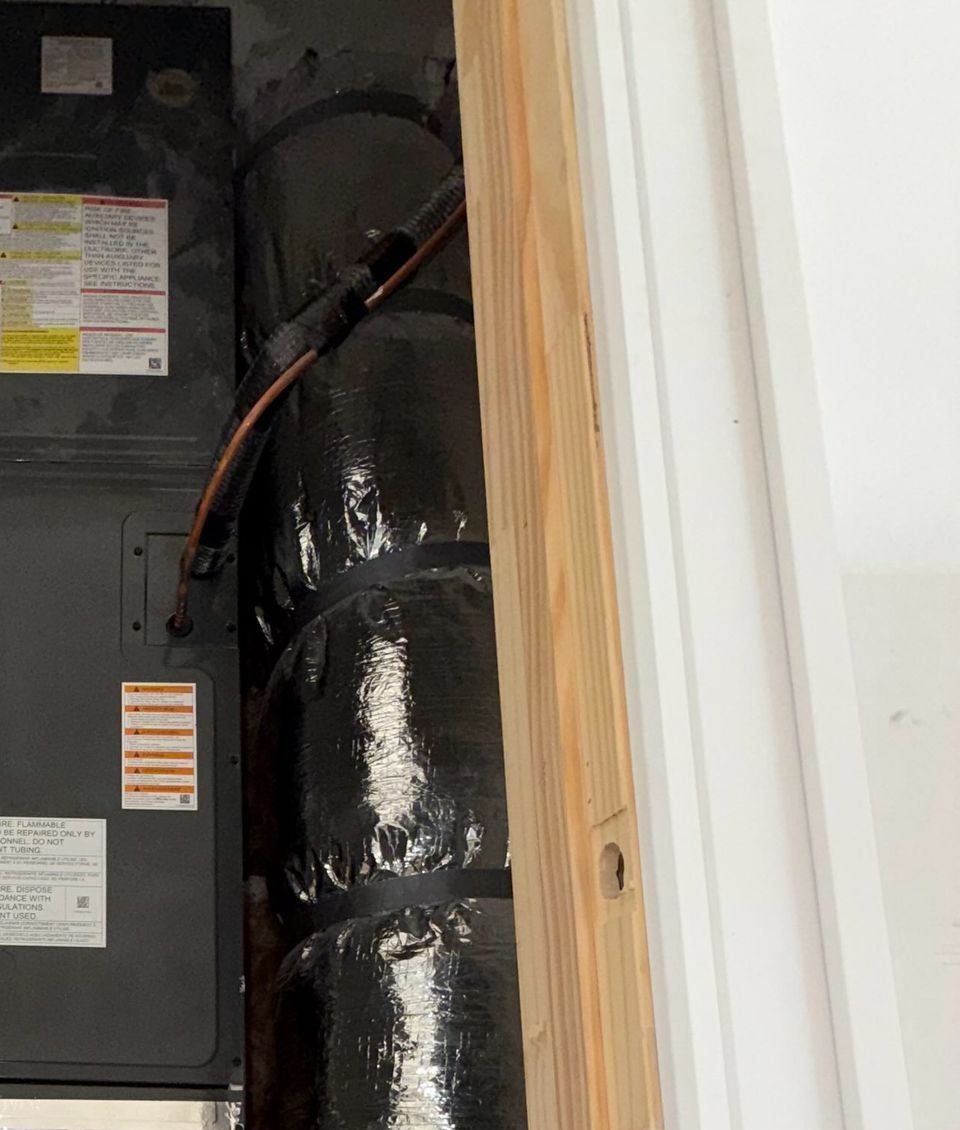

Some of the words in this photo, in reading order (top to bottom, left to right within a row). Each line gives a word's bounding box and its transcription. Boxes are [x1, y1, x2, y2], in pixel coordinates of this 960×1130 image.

[17, 821, 66, 829] FLAMMABLE
[3, 829, 15, 837] BE
[16, 829, 59, 838] REPAIRED
[60, 830, 82, 839] ONLY
[84, 830, 96, 838] BY
[32, 838, 46, 846] DO
[46, 838, 65, 846] NOT
[16, 886, 53, 894] DISPOSE
[29, 894, 52, 903] WITH
